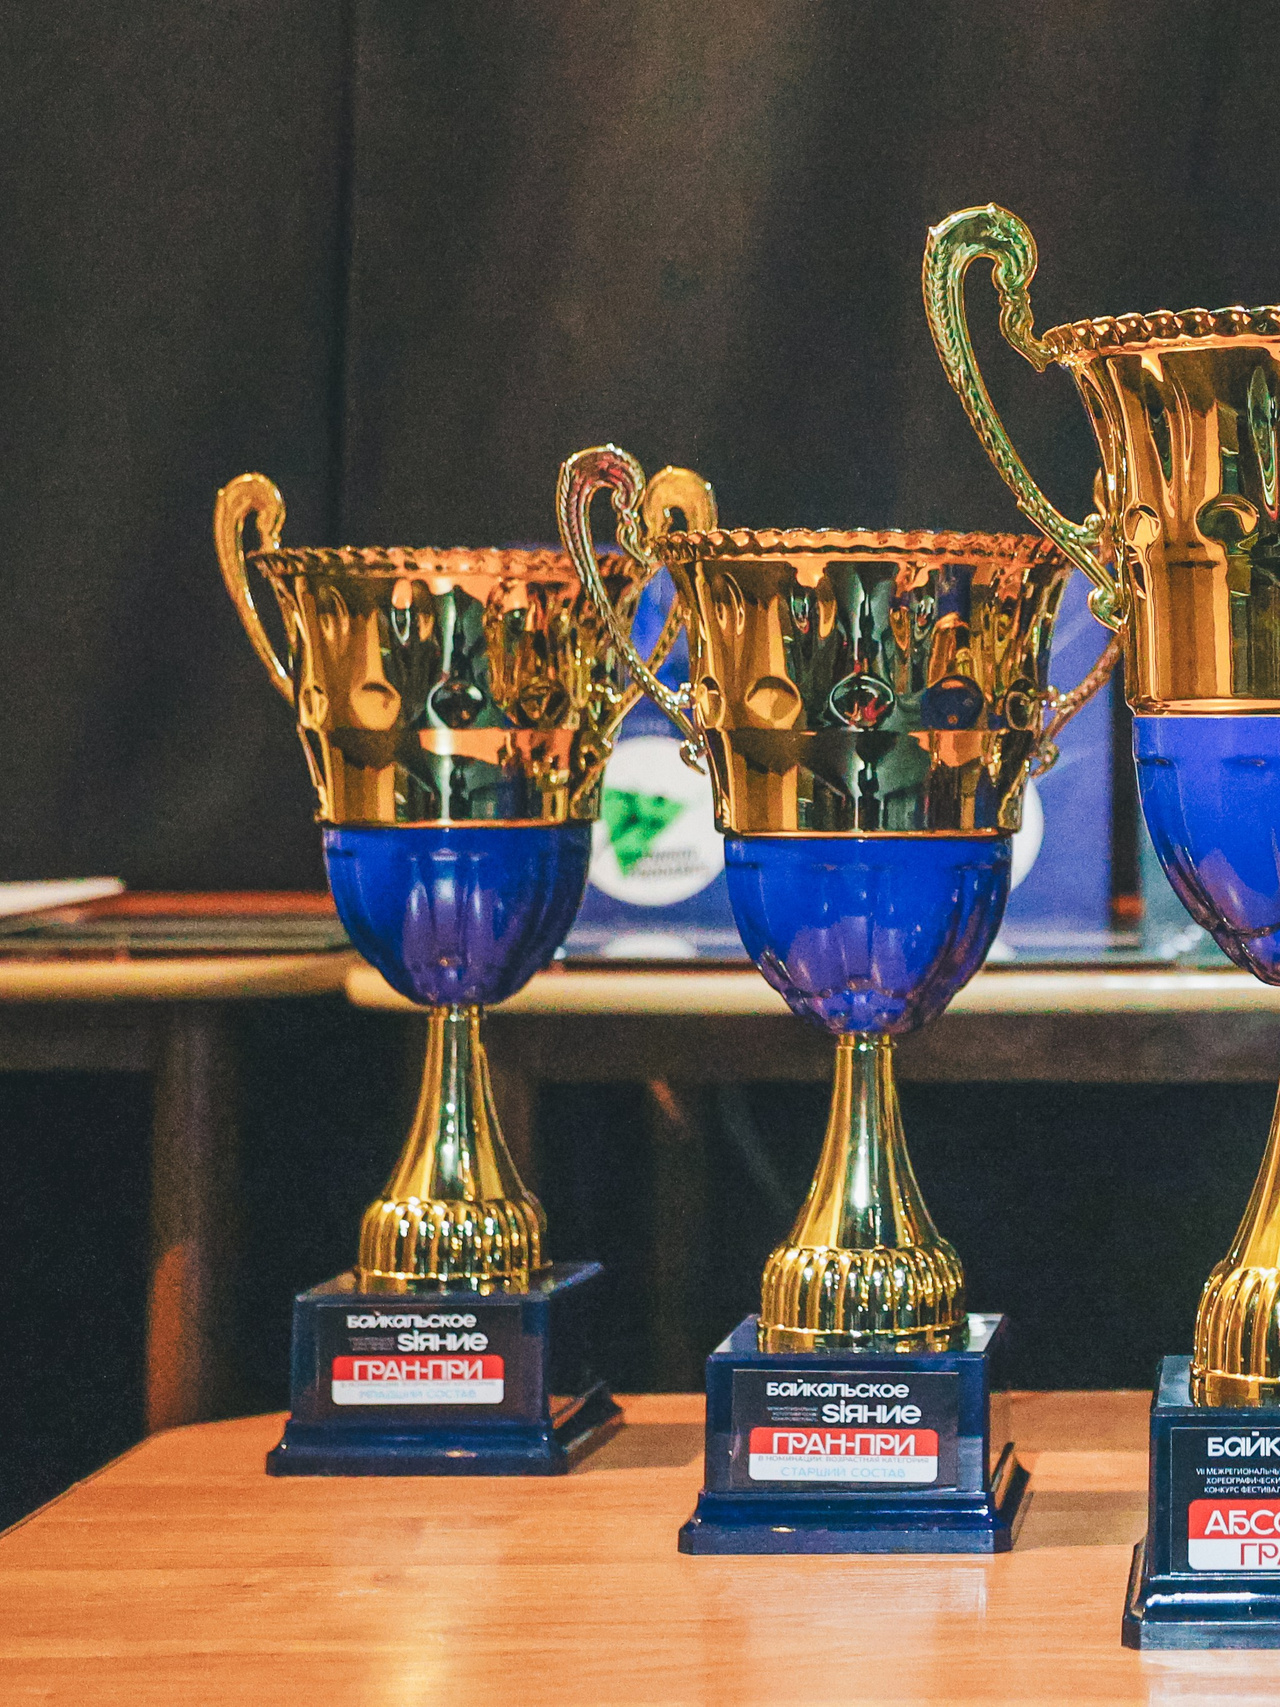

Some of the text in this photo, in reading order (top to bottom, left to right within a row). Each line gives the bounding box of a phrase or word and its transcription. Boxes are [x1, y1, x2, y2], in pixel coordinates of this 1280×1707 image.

[353, 1360, 484, 1380] ГРАН-ПРИ
[772, 1432, 916, 1455] ГРАН-ПРИ
[1203, 1486, 1240, 1494] КОНКУРС
